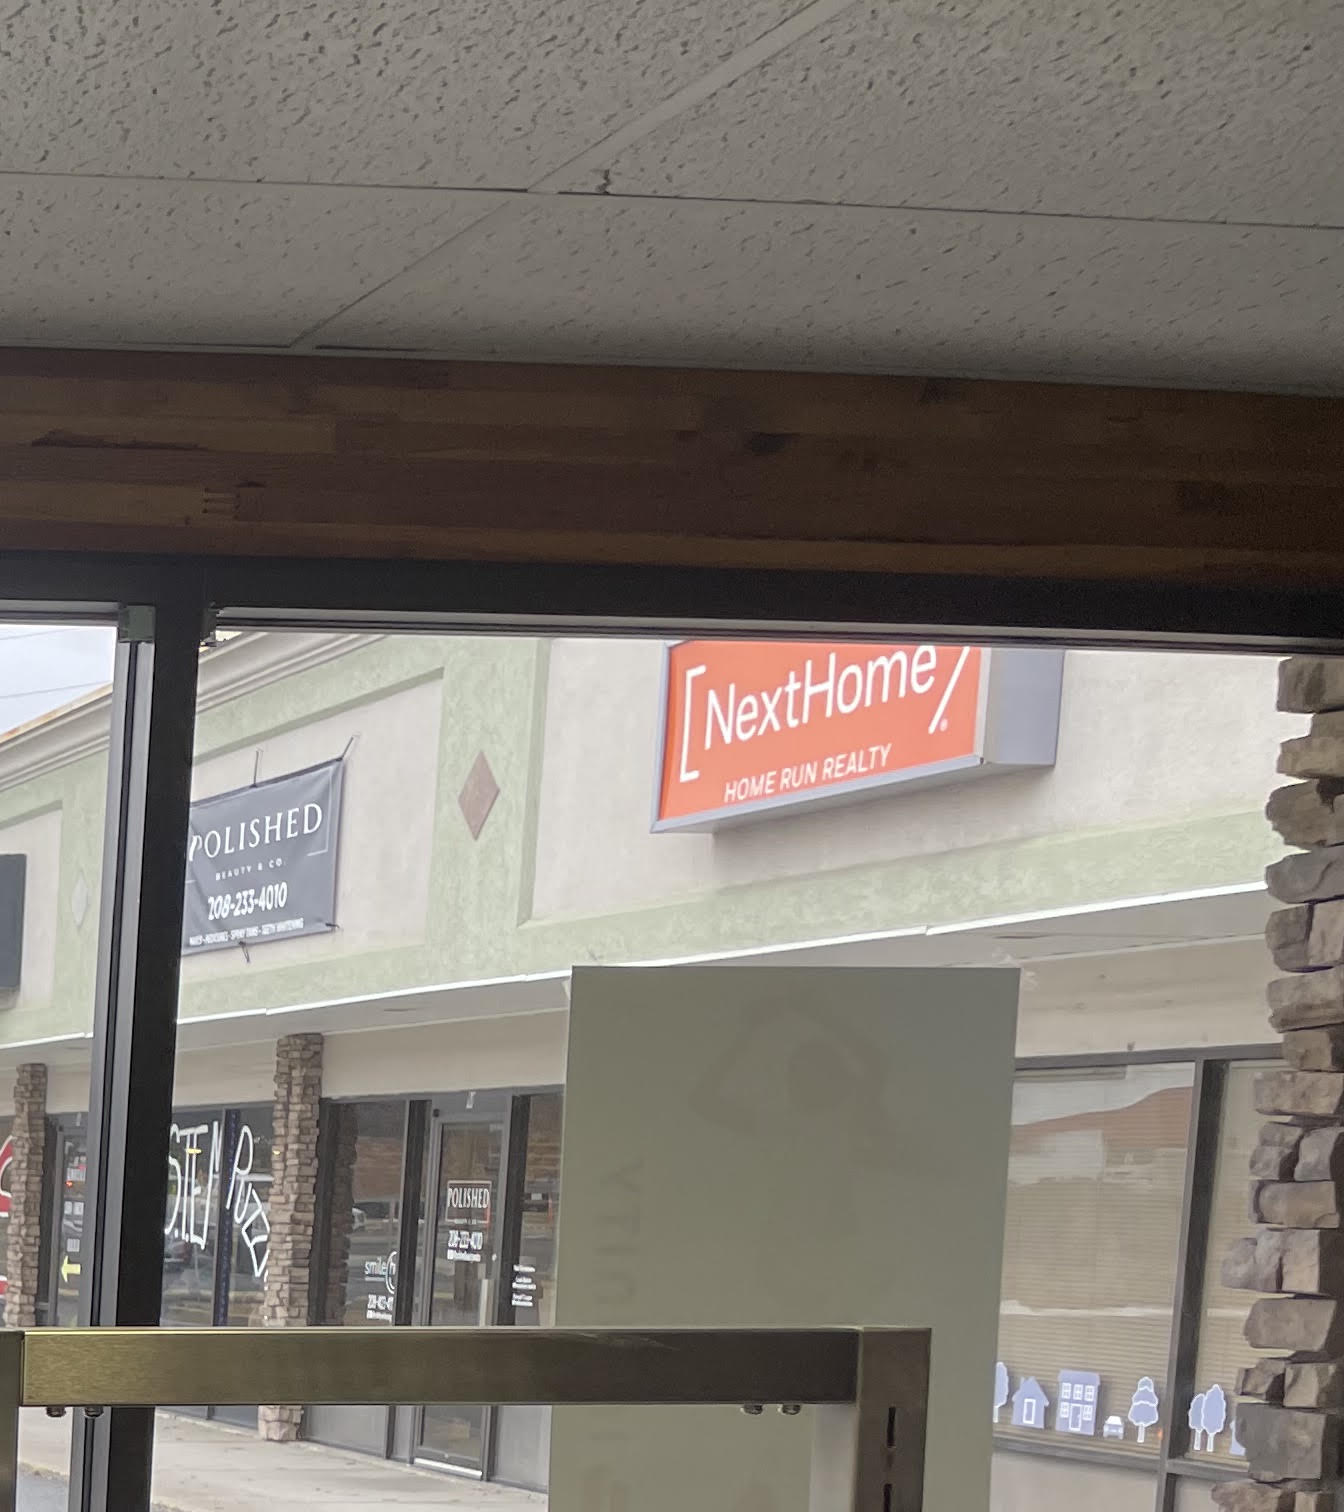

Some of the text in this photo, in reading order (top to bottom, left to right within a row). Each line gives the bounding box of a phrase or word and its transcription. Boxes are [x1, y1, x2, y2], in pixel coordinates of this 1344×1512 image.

[704, 643, 937, 750] NextHome
[723, 742, 893, 804] HOME RUN REALTY
[188, 803, 323, 862] POLISHED
[215, 865, 252, 881] BEAUTY
[207, 881, 288, 920] 208-233-4010
[448, 1188, 490, 1209] POLISHED
